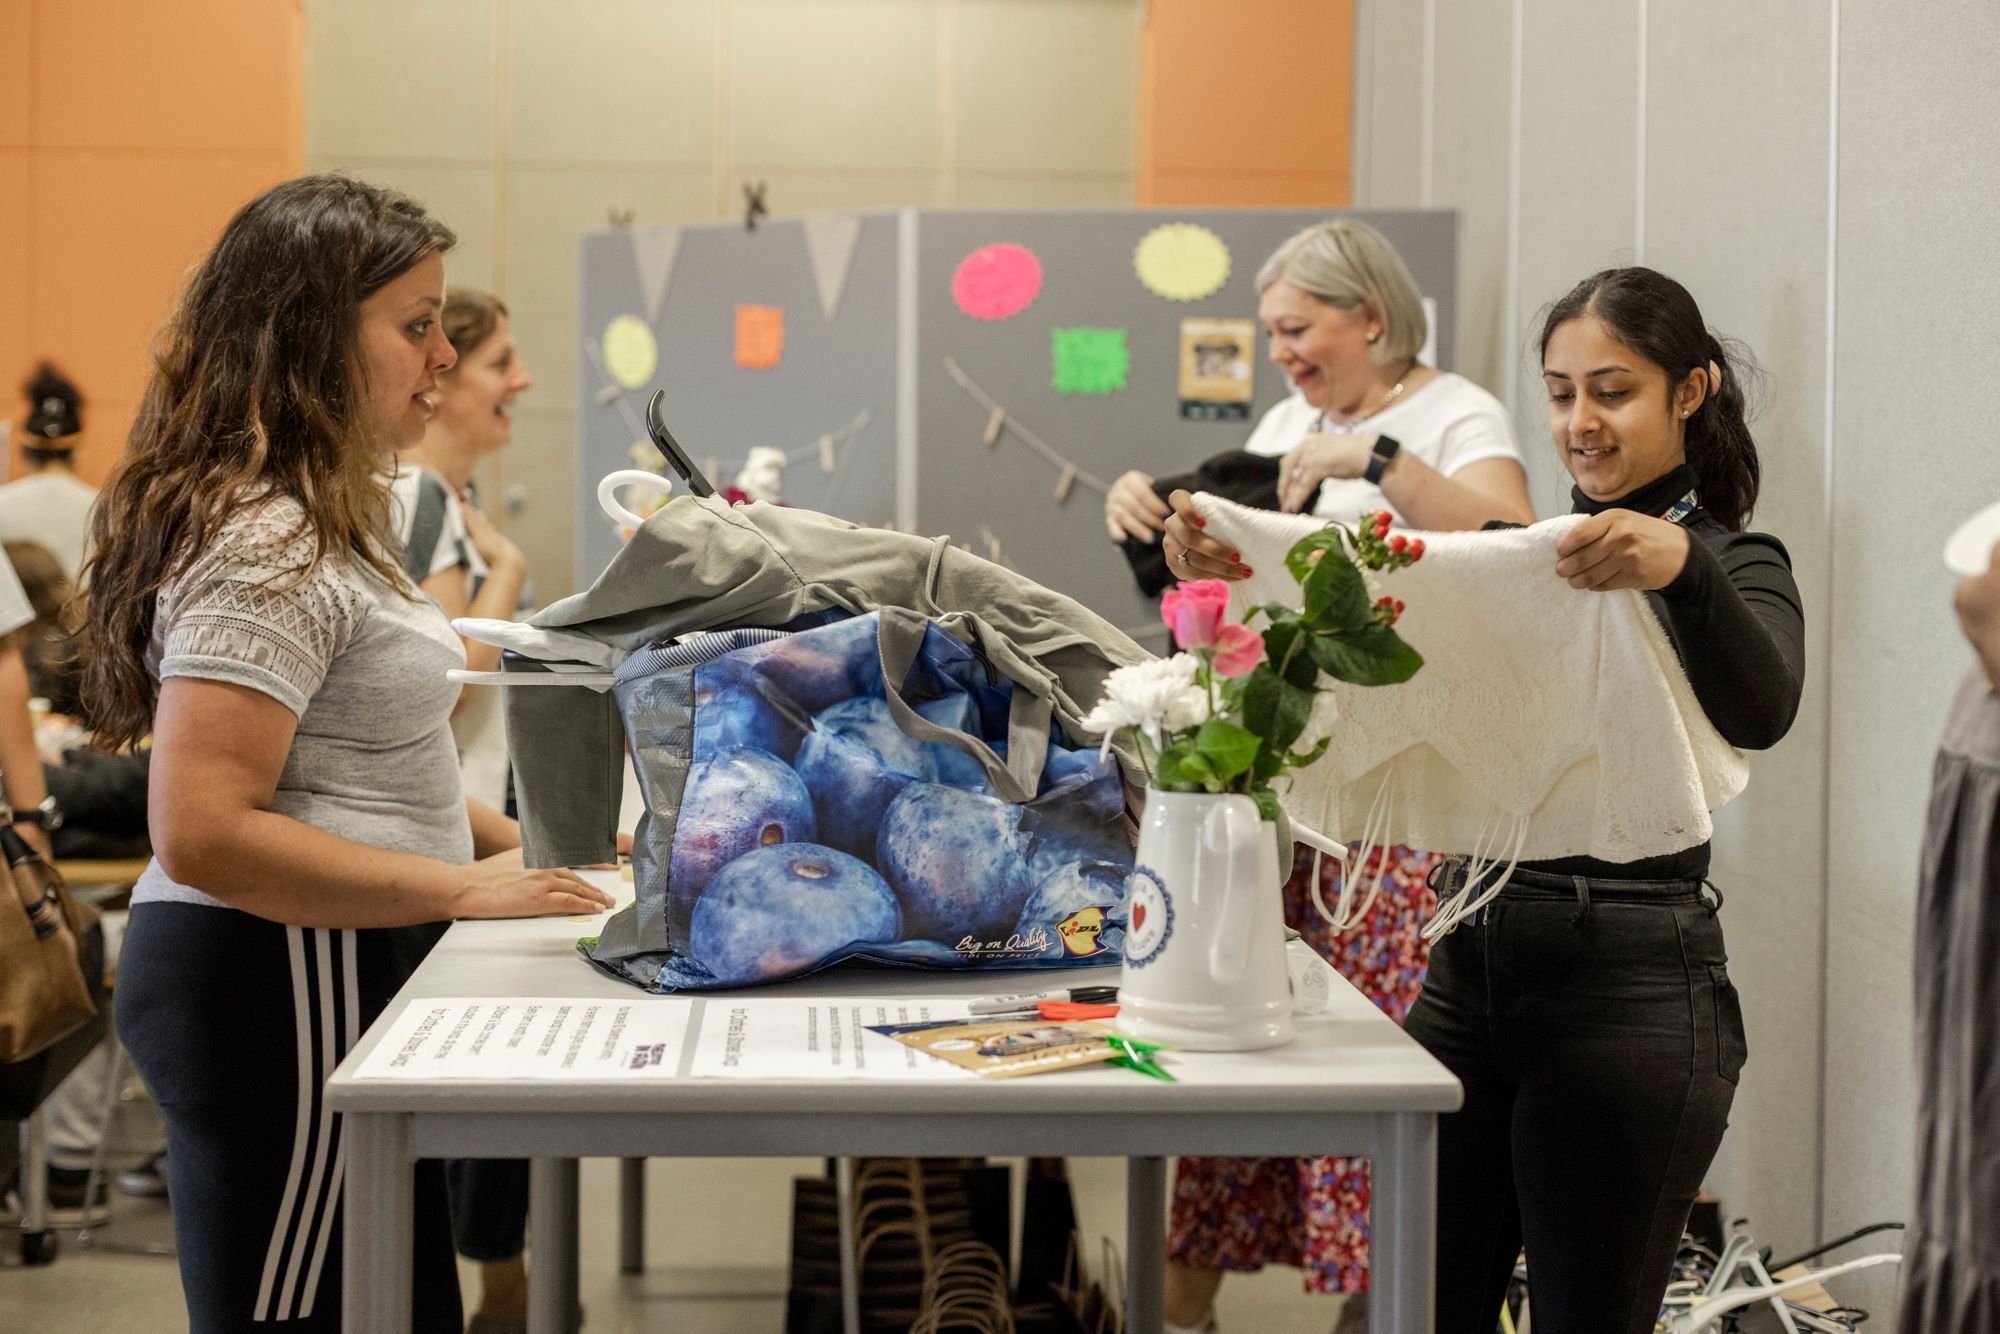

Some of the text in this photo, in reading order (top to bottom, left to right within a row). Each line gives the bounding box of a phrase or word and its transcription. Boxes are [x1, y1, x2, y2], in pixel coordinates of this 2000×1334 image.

[954, 926, 1050, 953] Big on Quality
